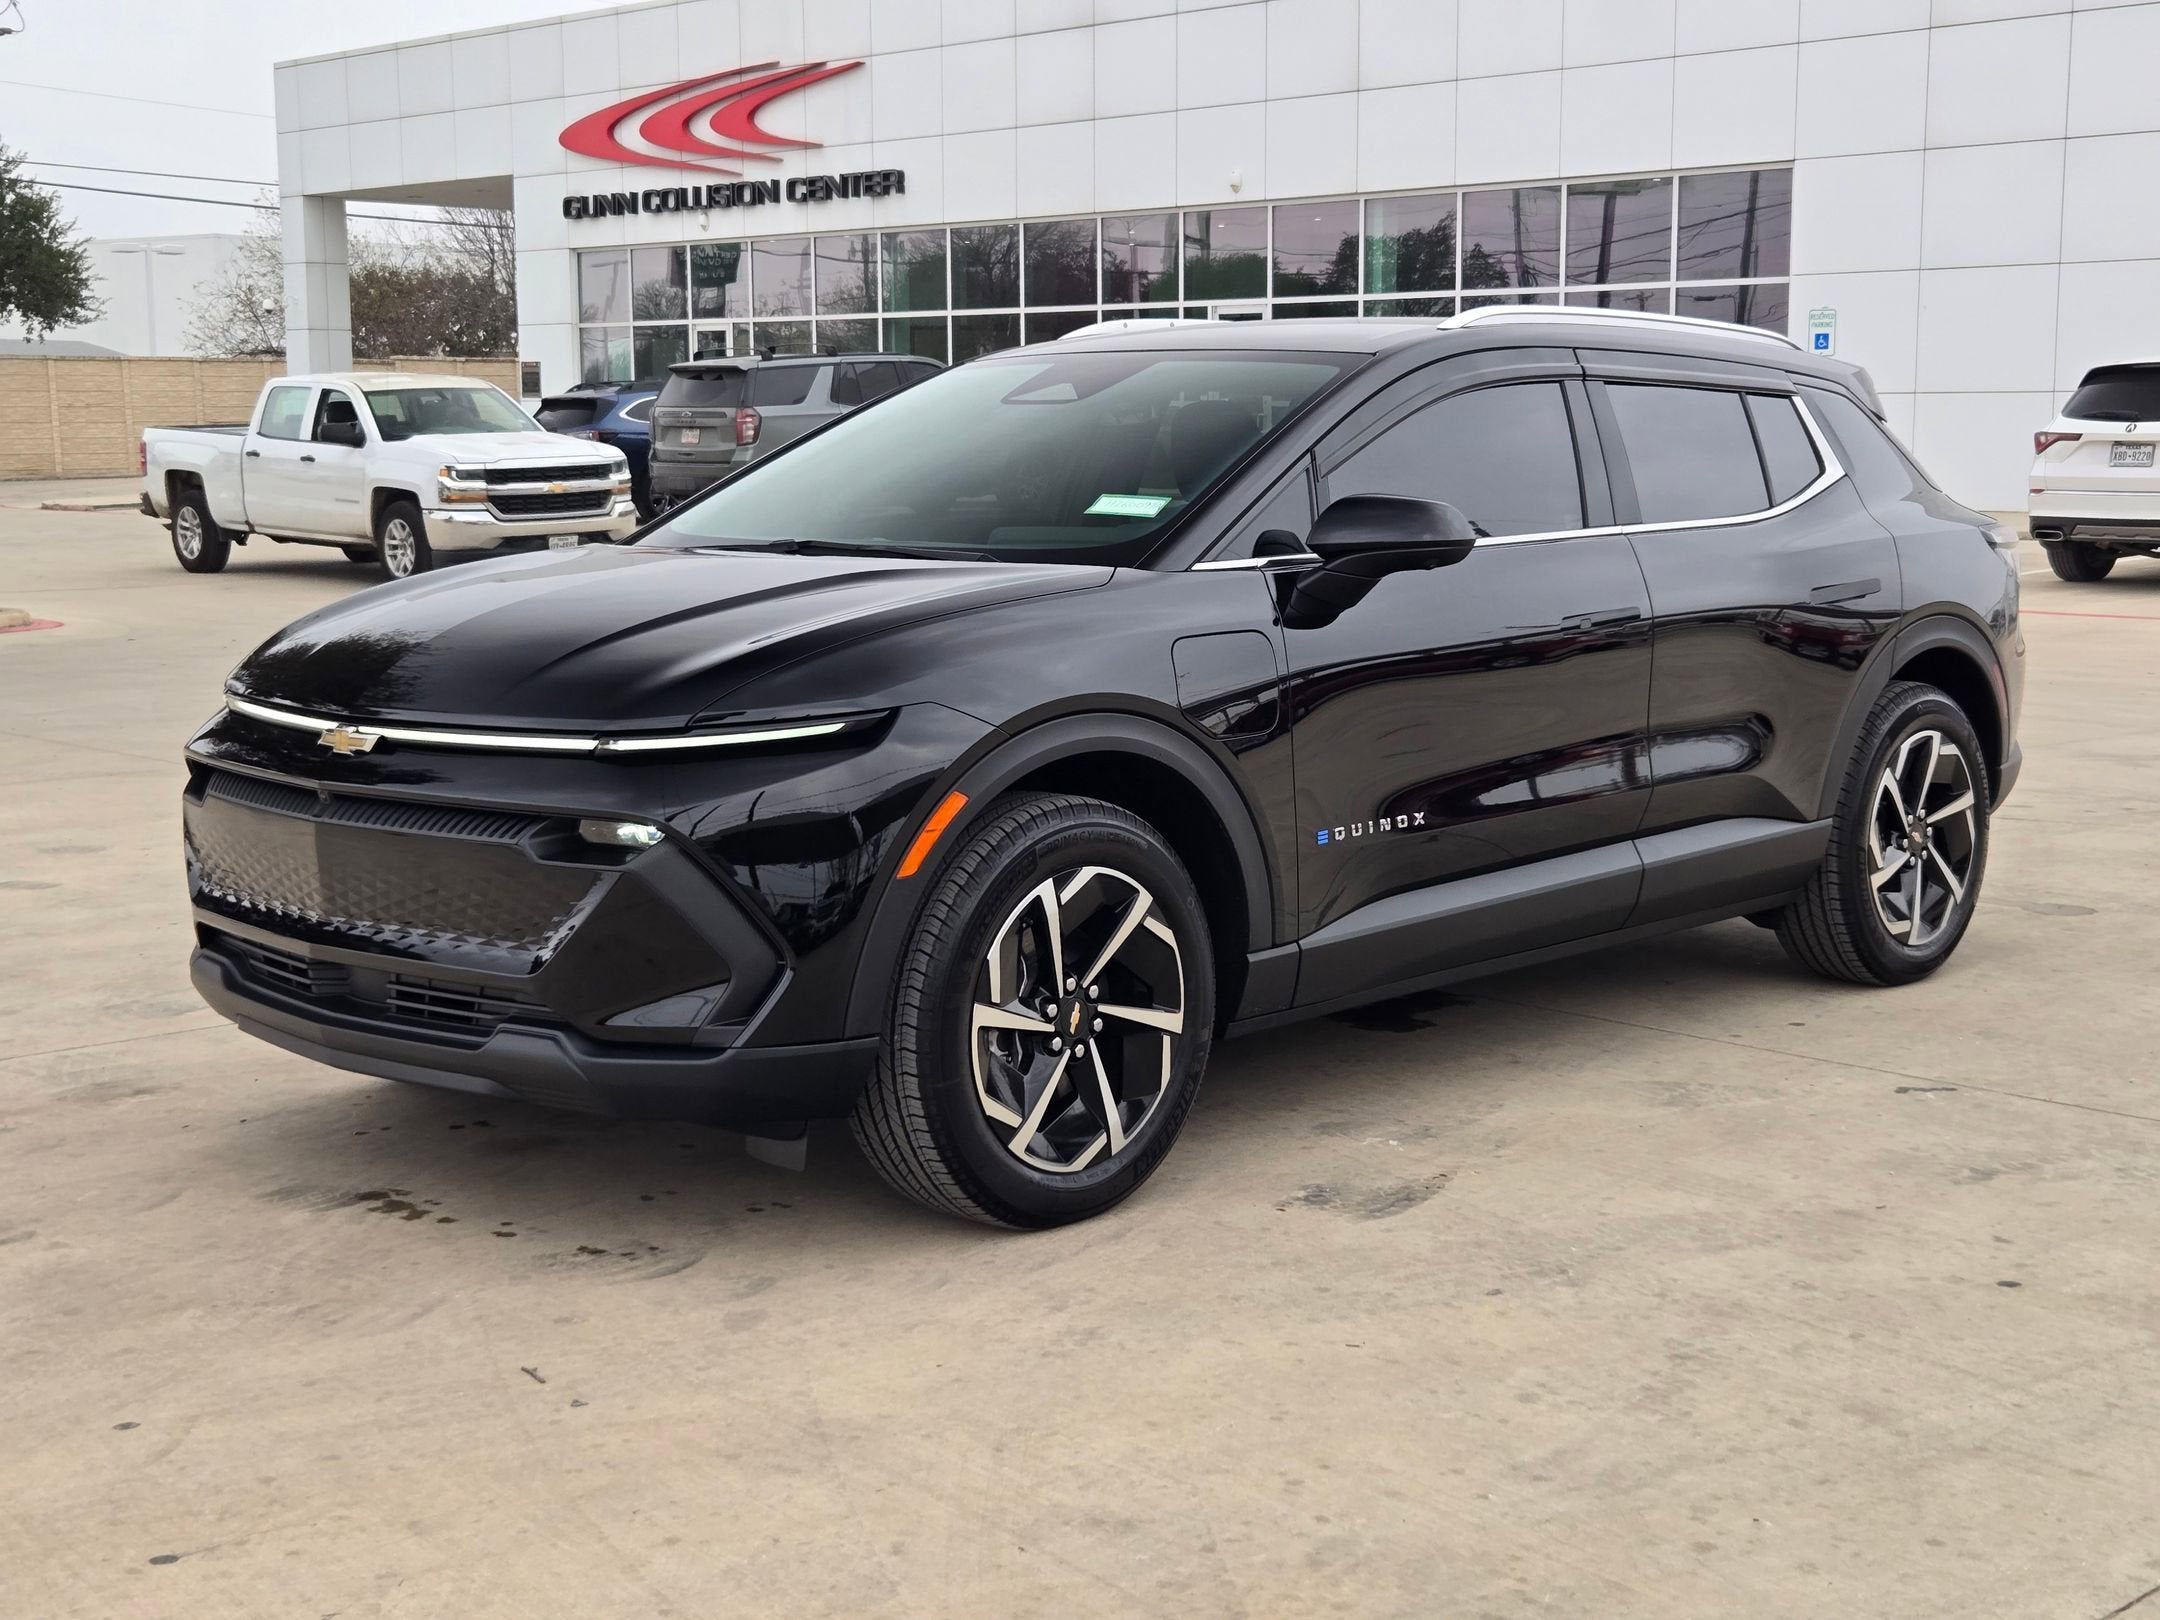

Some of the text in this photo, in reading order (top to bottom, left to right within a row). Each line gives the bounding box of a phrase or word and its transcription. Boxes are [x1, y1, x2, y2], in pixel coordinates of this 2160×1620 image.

[563, 169, 906, 219] GUNN COLLISION CENTER
